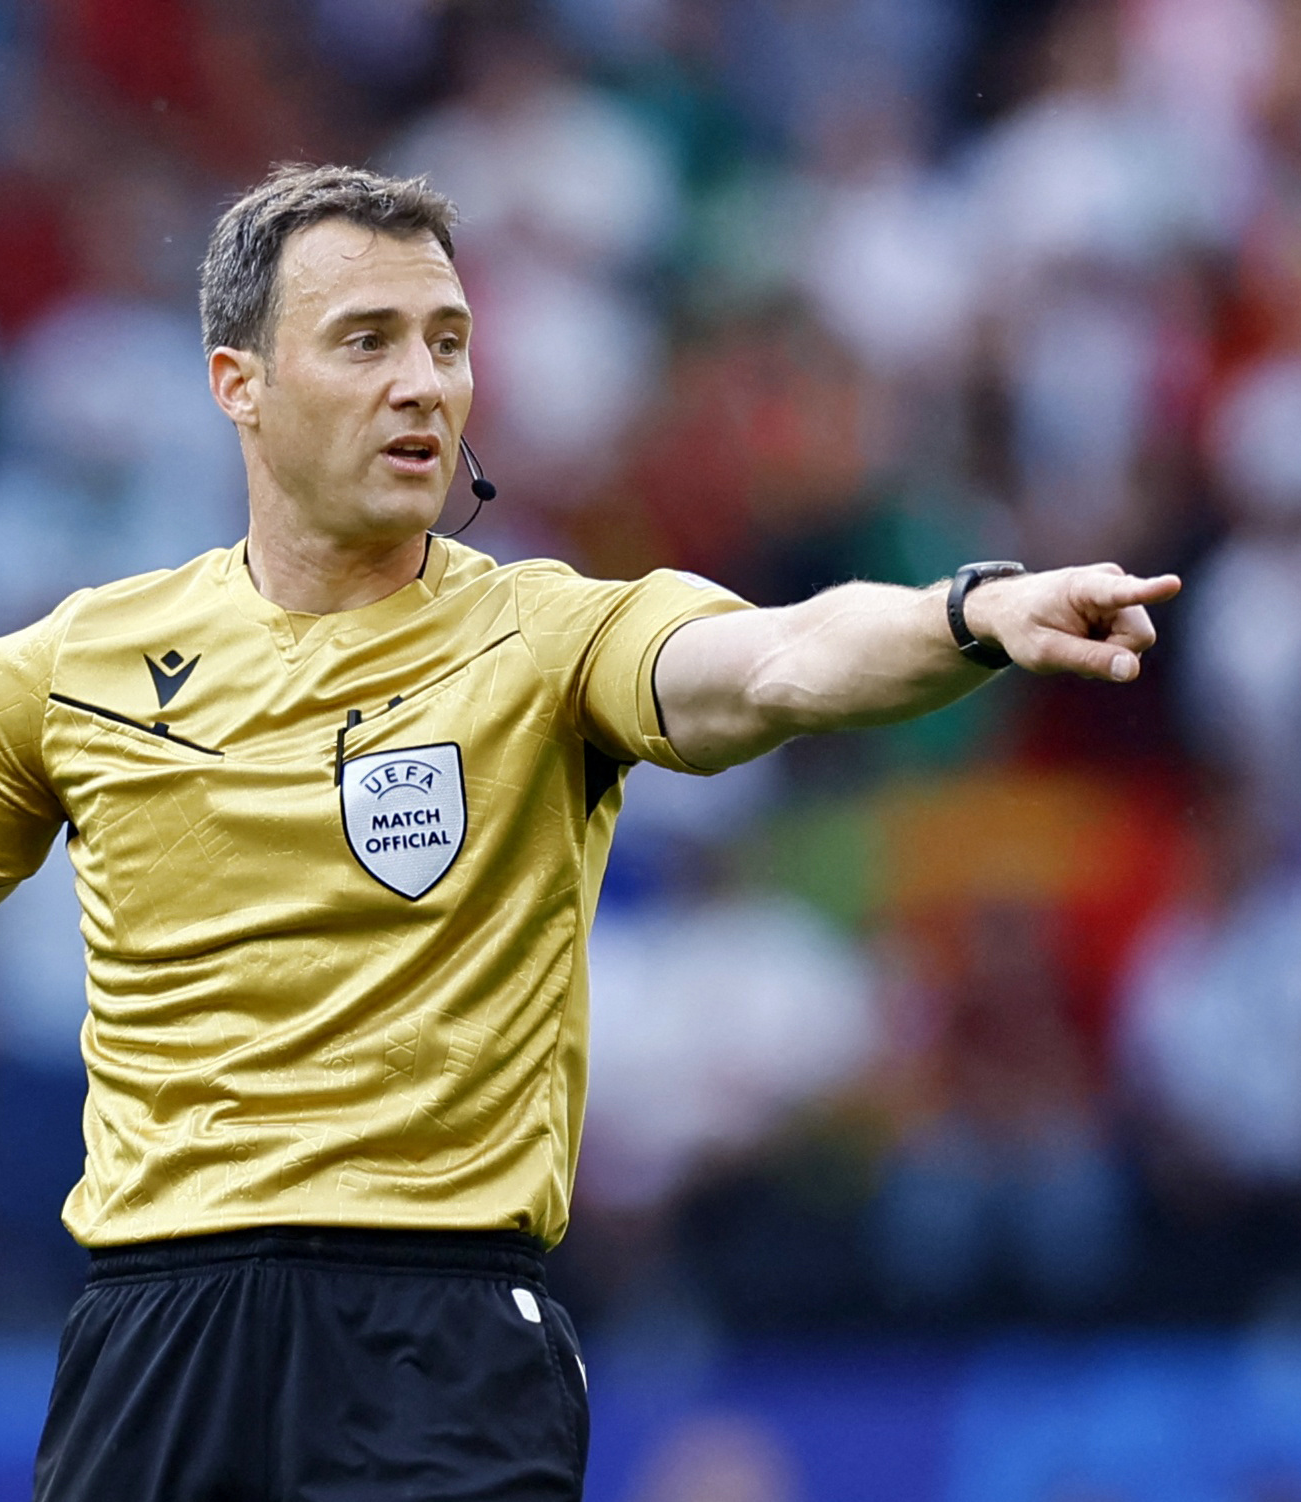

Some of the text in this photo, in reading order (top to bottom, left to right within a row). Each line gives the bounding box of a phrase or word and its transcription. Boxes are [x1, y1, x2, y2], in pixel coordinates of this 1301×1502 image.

[365, 766, 434, 794] UEFA
[372, 808, 441, 831] MATCH
[365, 830, 451, 854] OFFICIAL
